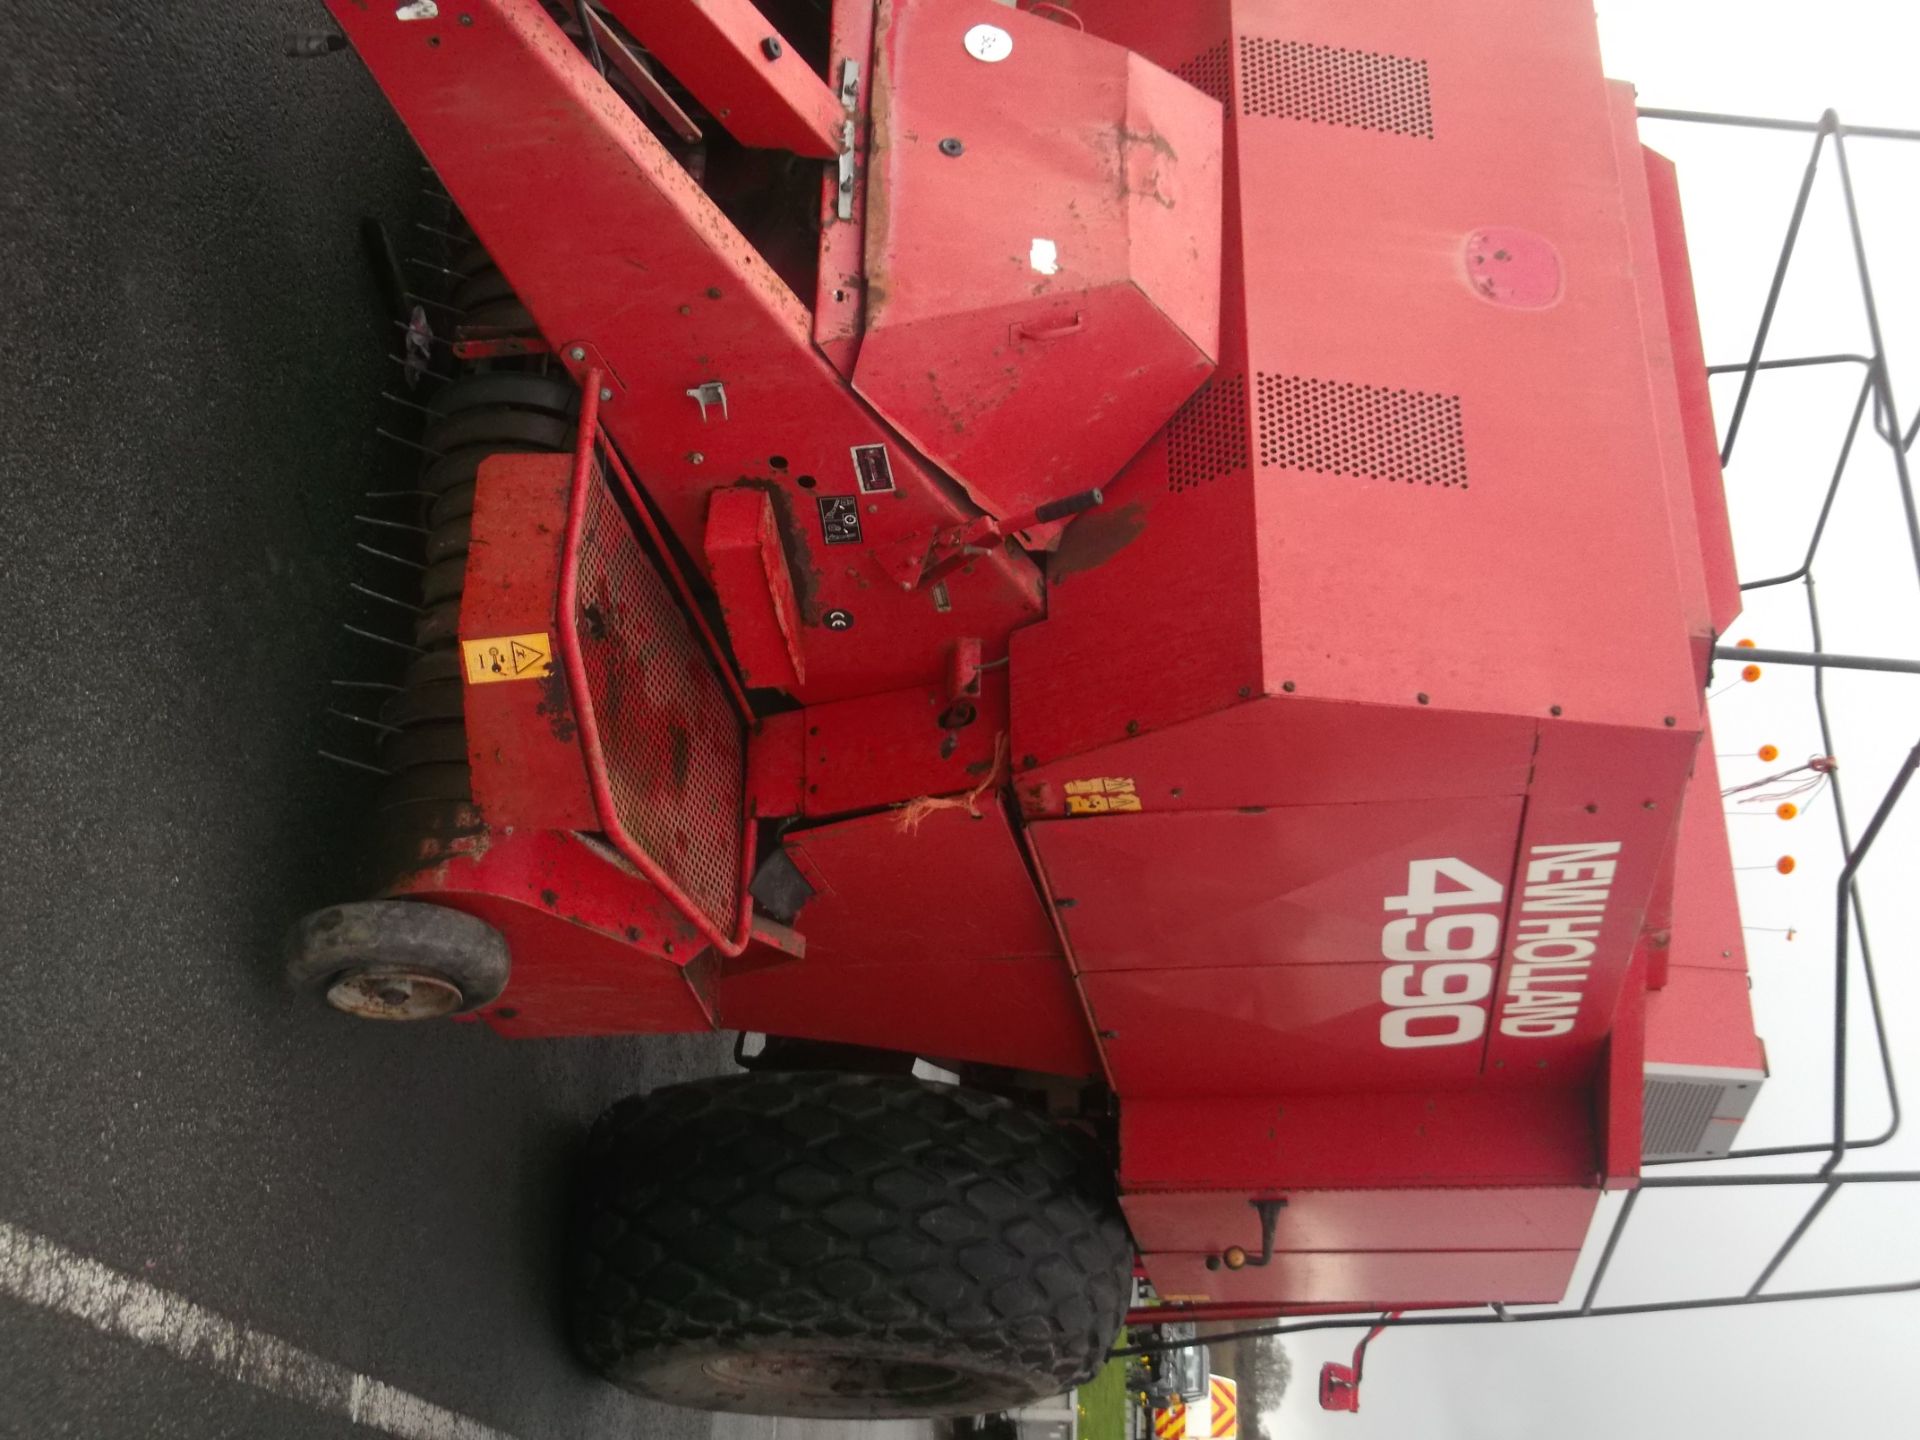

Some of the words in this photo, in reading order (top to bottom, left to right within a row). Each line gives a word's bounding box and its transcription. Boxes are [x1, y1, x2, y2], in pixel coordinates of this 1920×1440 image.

[830, 612, 846, 627] CE
[1521, 841, 1621, 911] NEW
[1380, 857, 1504, 1048] 4990
[1500, 916, 1603, 1037] HOLLAND
